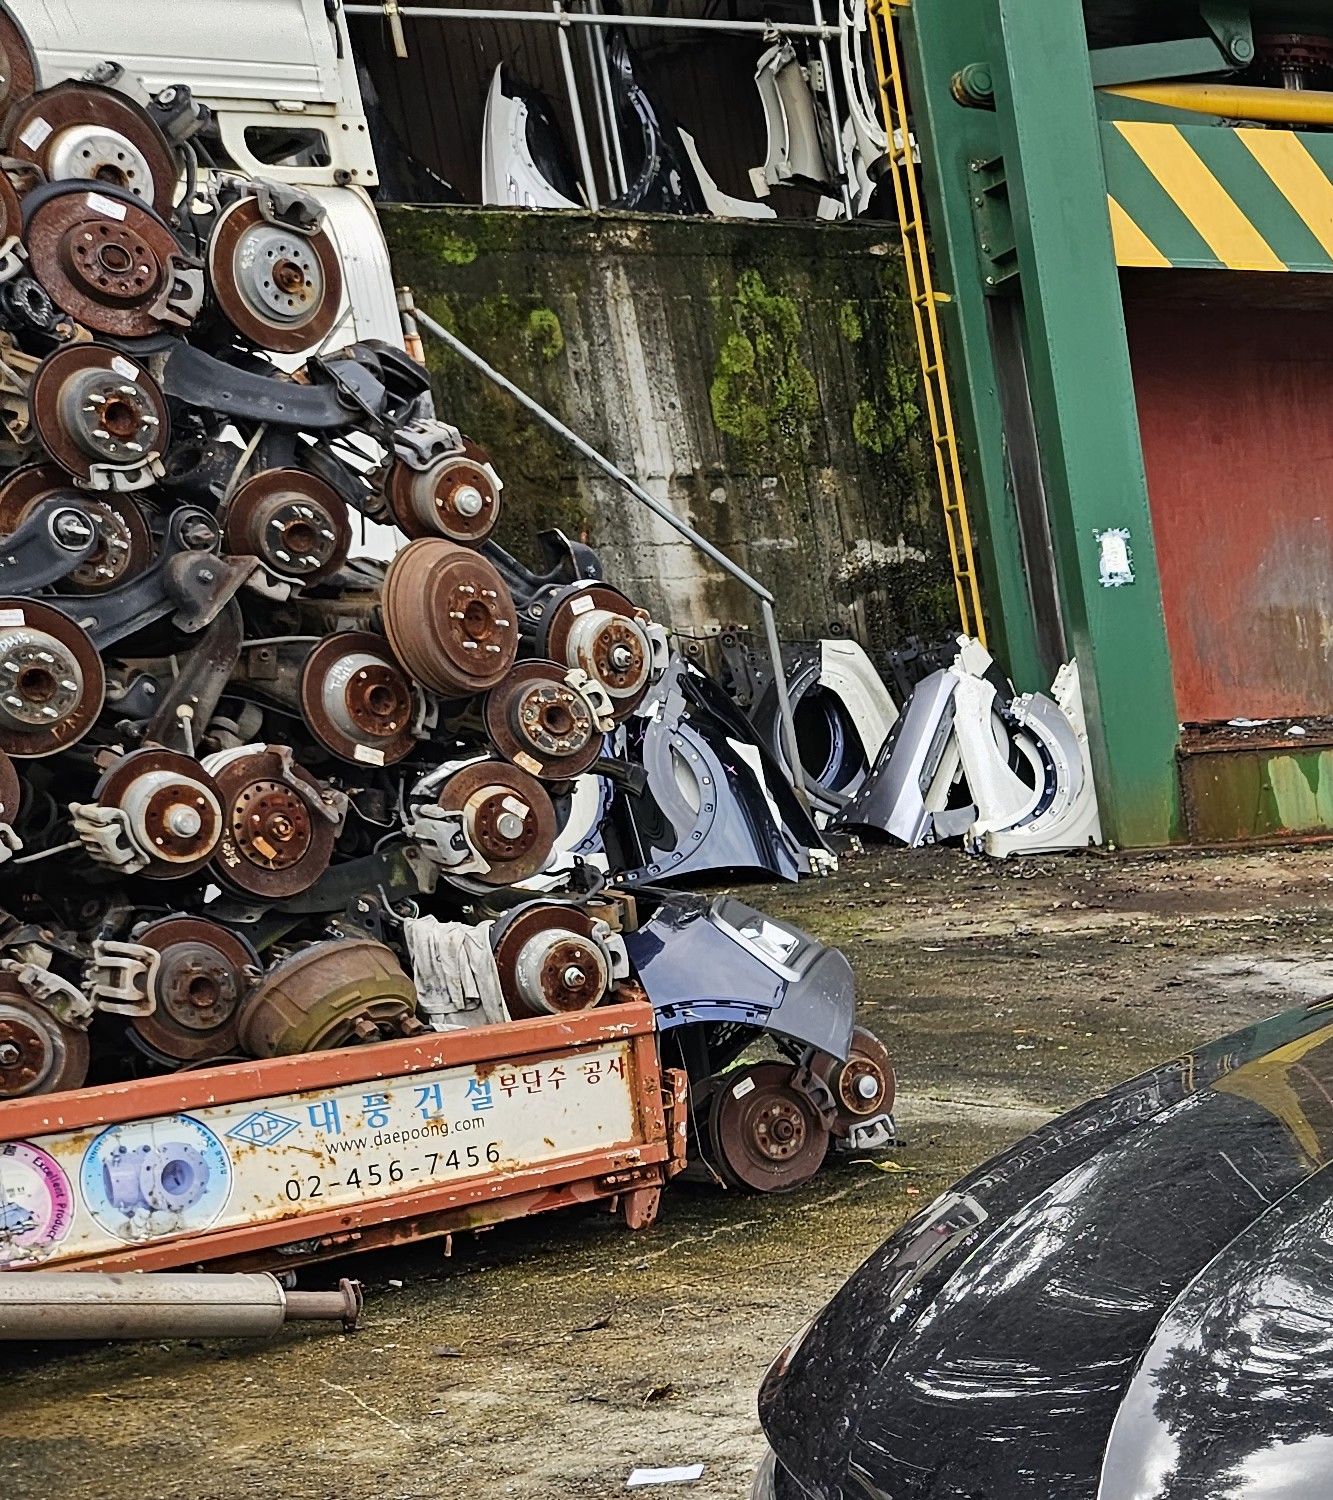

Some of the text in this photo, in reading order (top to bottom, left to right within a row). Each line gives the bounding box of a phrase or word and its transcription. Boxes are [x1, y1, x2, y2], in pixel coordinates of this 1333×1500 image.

[500, 1068, 567, 1098] 부단수
[584, 1056, 626, 1085] 공사
[325, 1116, 485, 1155] www.daepoong.com
[32, 1156, 65, 1198] Excellent
[285, 1142, 500, 1201] 02-456-7456
